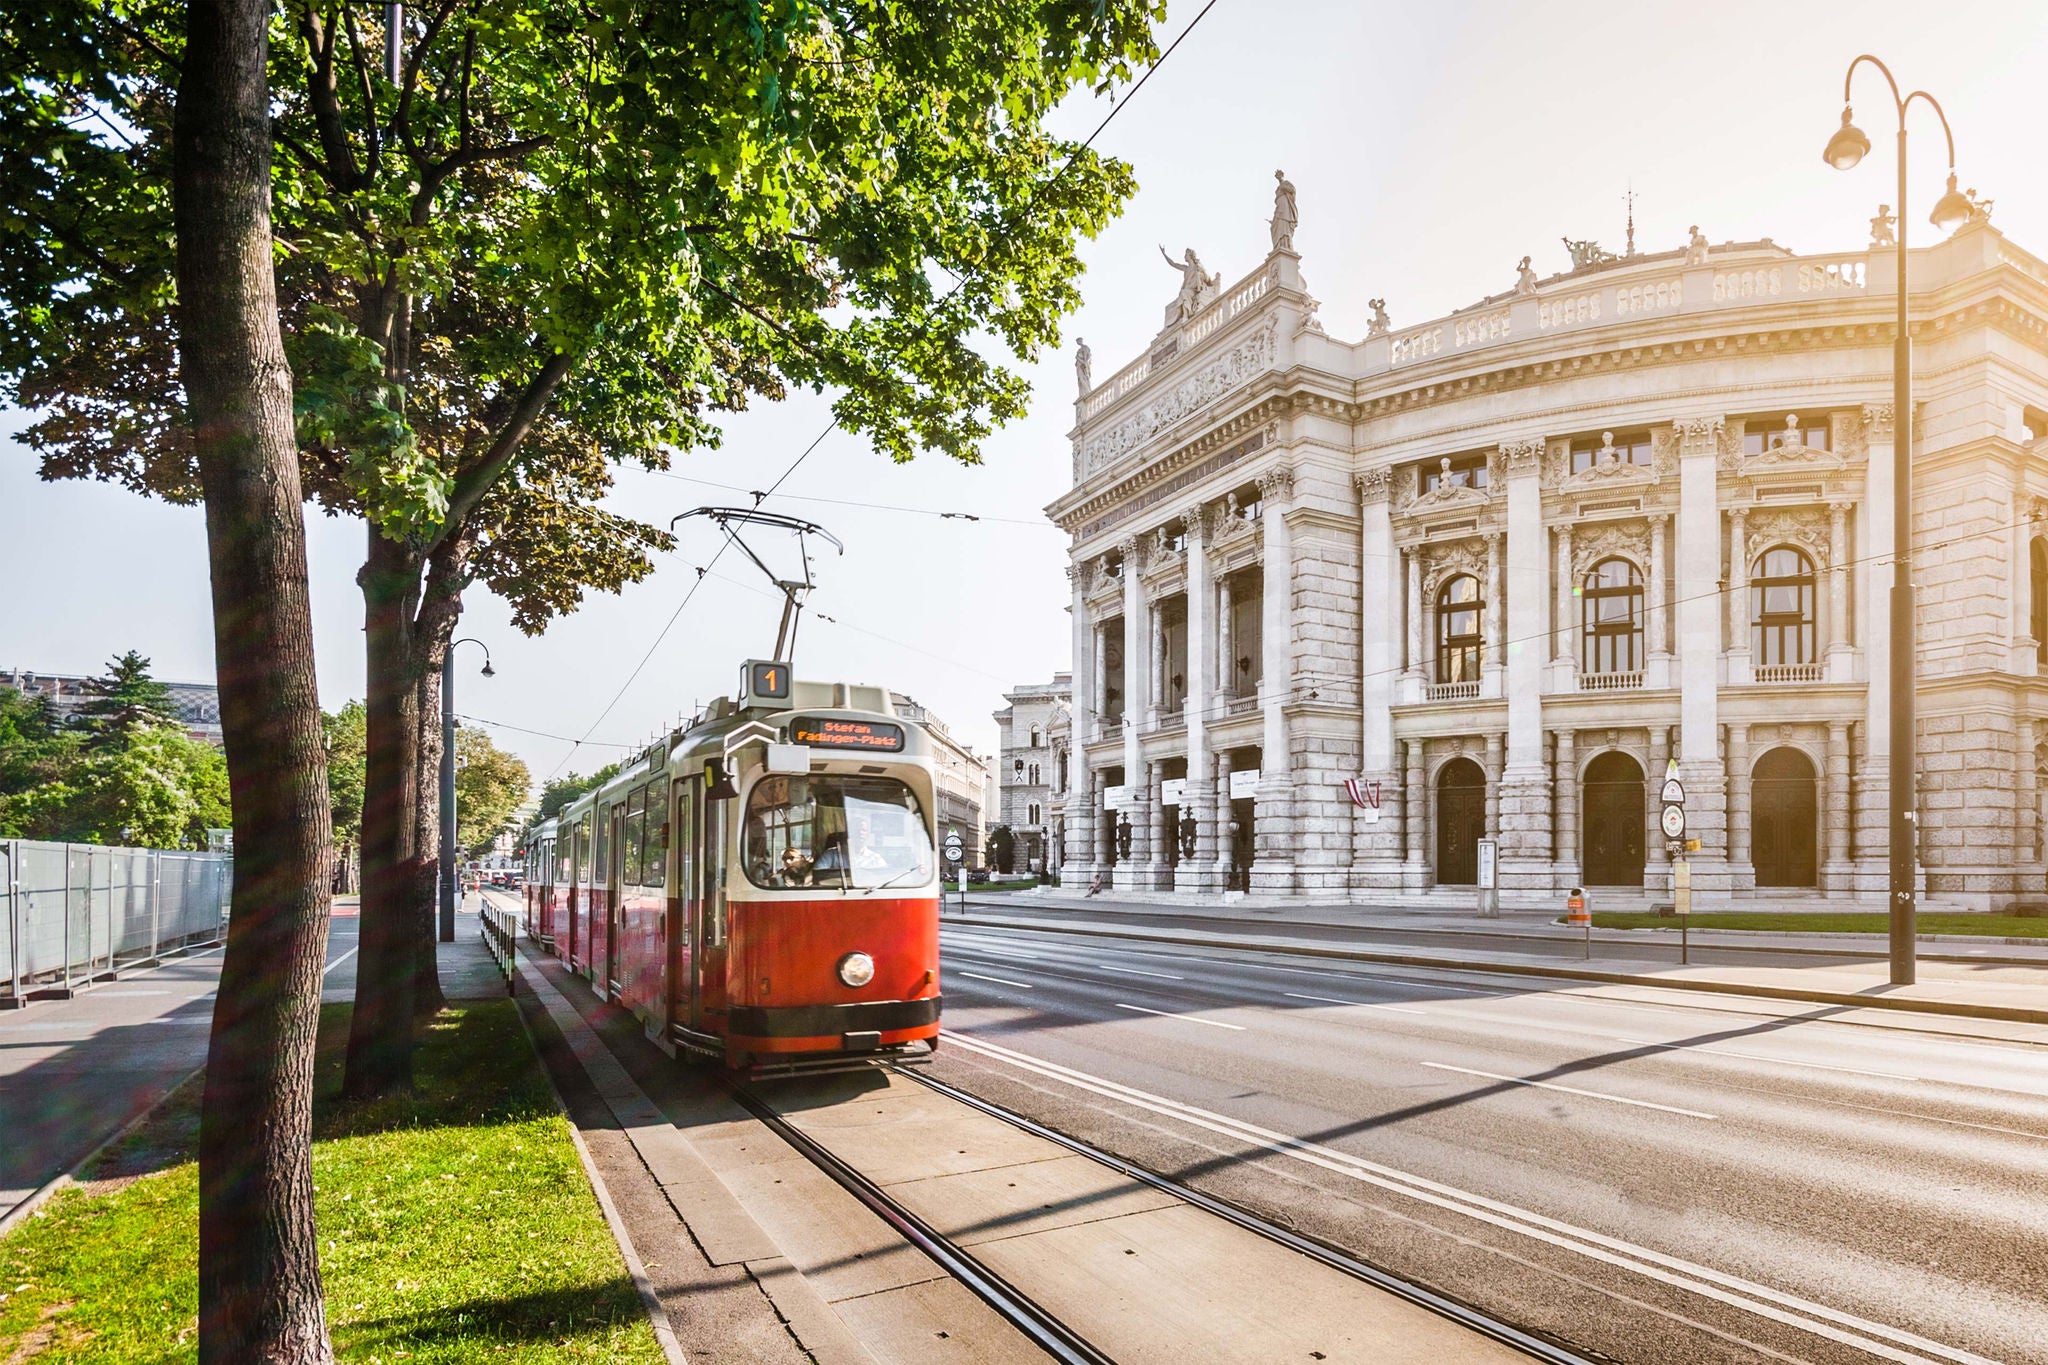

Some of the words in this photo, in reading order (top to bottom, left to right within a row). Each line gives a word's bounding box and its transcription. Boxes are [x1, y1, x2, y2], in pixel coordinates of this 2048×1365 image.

[765, 669, 777, 692] 1
[823, 722, 871, 734] Stefan
[797, 731, 897, 747] Fadinger-Platz
